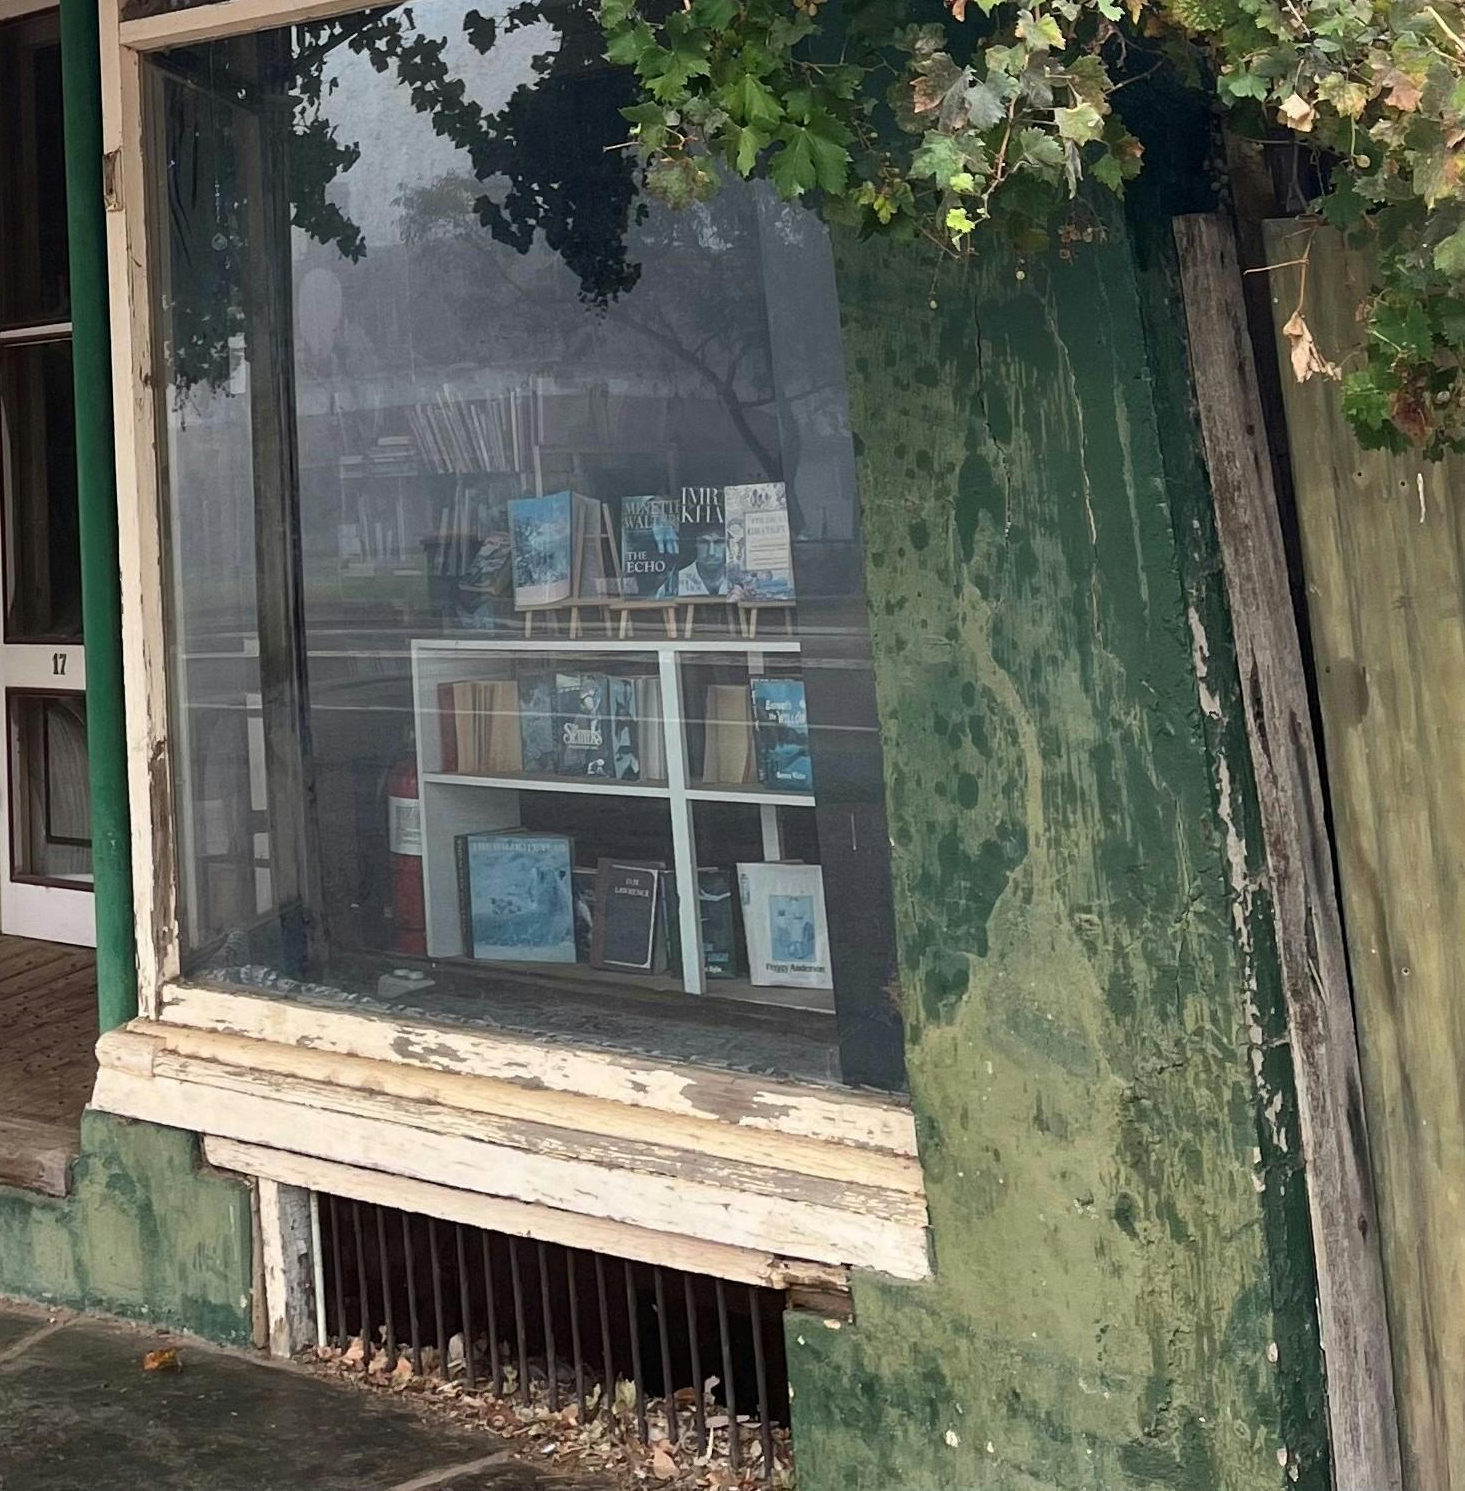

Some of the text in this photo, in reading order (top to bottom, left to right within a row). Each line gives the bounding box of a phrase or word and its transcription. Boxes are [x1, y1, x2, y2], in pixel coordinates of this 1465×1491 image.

[626, 551, 648, 561] THE
[626, 560, 666, 574] ECHO
[51, 652, 68, 676] 17
